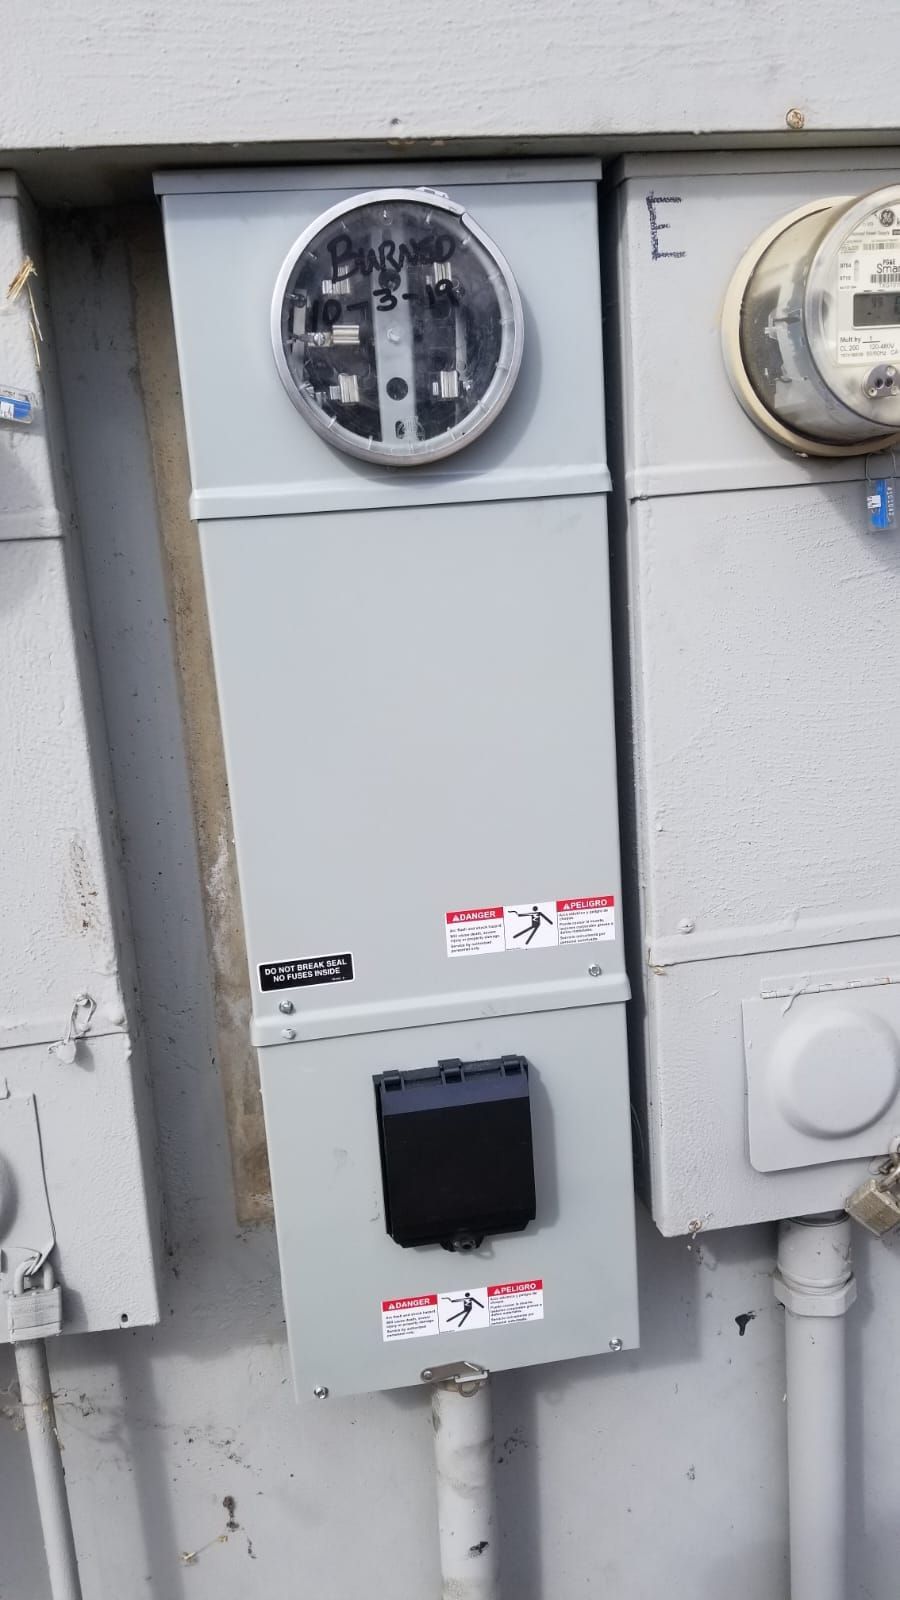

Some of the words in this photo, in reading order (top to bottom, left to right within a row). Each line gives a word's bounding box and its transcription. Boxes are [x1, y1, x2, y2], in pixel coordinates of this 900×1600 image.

[646, 190, 685, 261] E
[571, 899, 608, 910] PELIGRO
[460, 910, 496, 921] DANGER
[265, 967, 276, 975] DO
[279, 965, 295, 974] NOT
[297, 962, 324, 971] BREAK
[326, 959, 348, 967] SEAL
[273, 975, 285, 983] NO
[287, 971, 313, 981] FUSES
[314, 967, 340, 976] INSIDE
[501, 1283, 536, 1293] PELIGRO
[396, 1298, 430, 1309] DANGER
